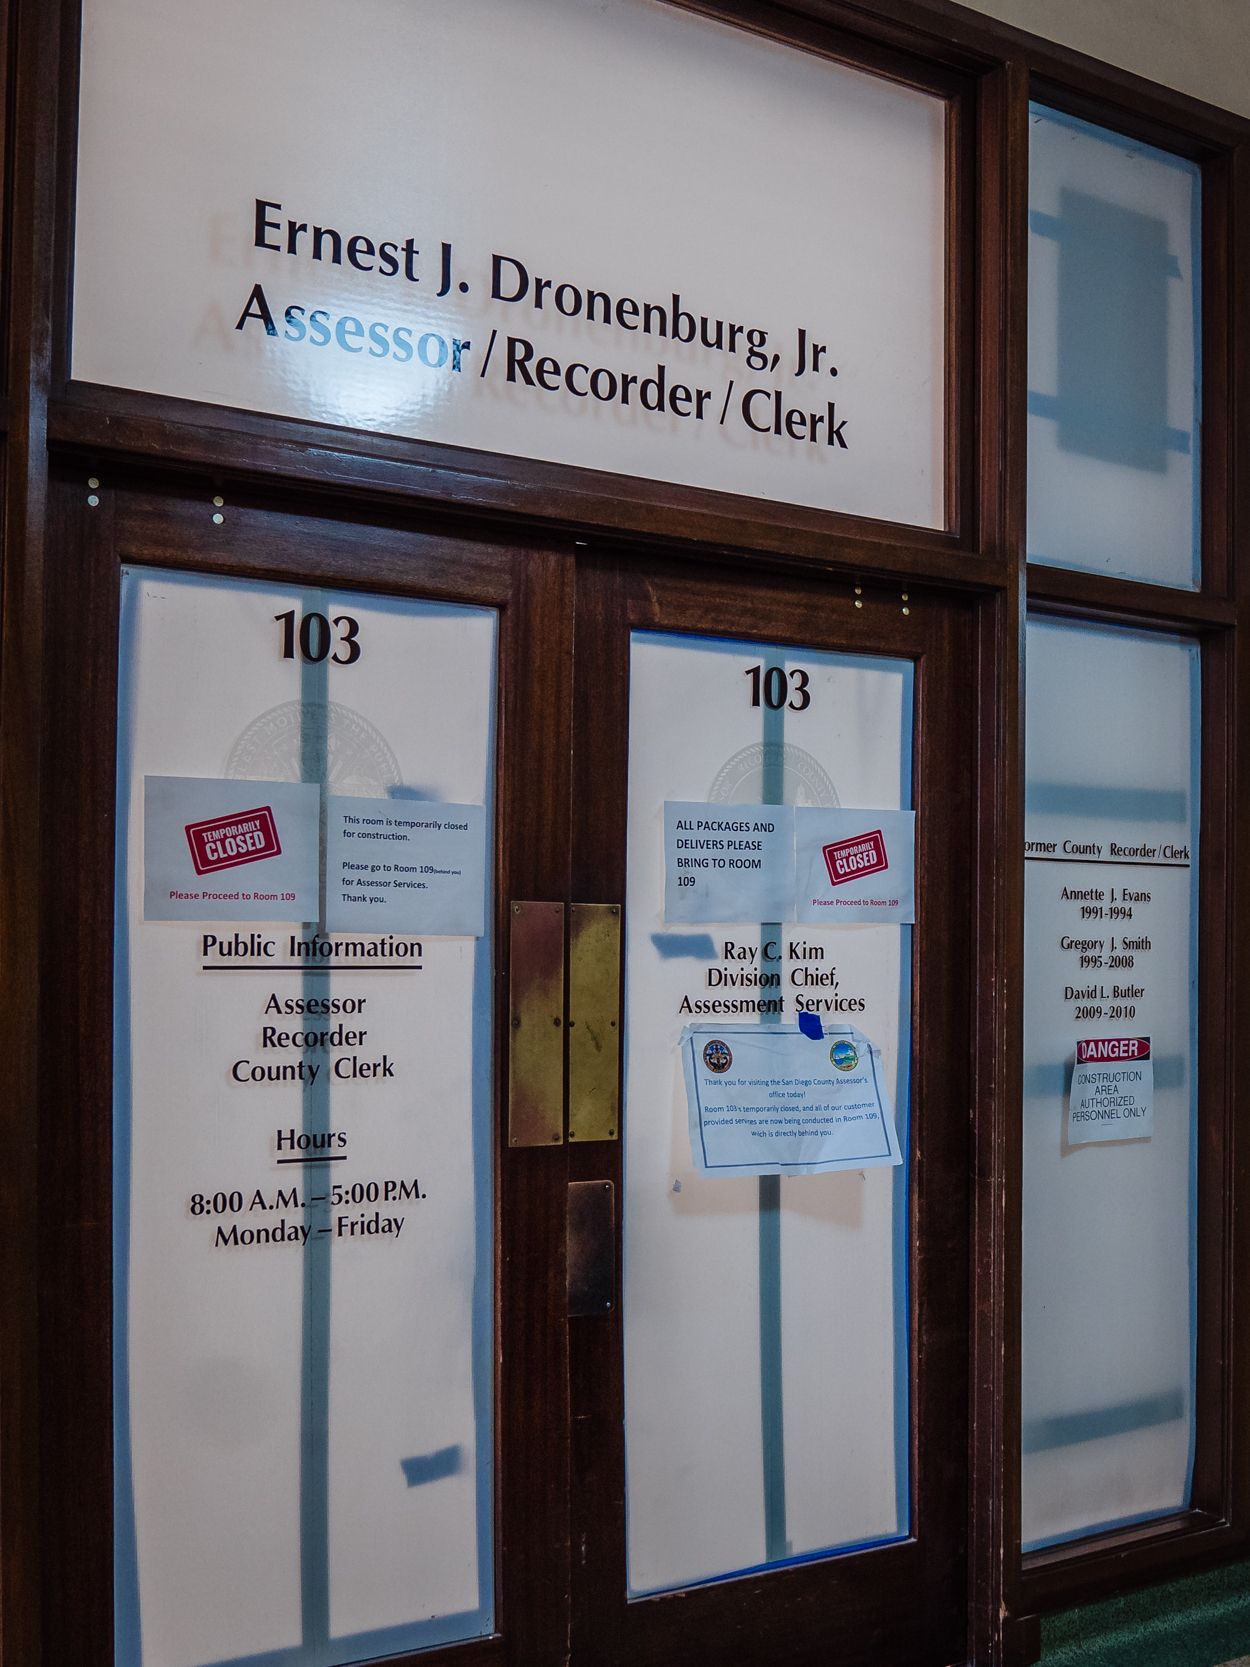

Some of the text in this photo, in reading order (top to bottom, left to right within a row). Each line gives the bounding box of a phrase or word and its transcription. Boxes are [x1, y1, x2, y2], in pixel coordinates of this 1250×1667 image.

[254, 198, 838, 377] Ernest J. Dronenburg, Jr.
[274, 609, 361, 665] 103
[744, 664, 811, 711] 103
[343, 815, 468, 831] This room is temporarily closed
[676, 820, 775, 833] ALL PACKAGES AND
[202, 820, 261, 843] TEMPORARILY
[343, 829, 411, 842] for construction.
[205, 830, 266, 861] CLOSED
[676, 839, 762, 851] DELIVERS PLEASE
[833, 840, 875, 859] TEMPORARILY
[1024, 841, 1058, 853] ormer
[1063, 840, 1103, 859] County
[342, 861, 369, 871] Please
[371, 864, 381, 873] go
[383, 864, 392, 872] to
[394, 864, 417, 873] Room
[677, 857, 762, 870] BRING TO ROOM
[836, 850, 878, 875] CLOSED
[342, 877, 428, 889] for Assessor Services.
[677, 876, 696, 887] 109
[169, 890, 296, 901] Please Proceed to Room 109
[342, 893, 387, 904] Thank you.
[812, 898, 899, 907] Please Proceed to Room 109
[1061, 886, 1151, 904] Annette J. Evans
[1080, 906, 1133, 920] 1991-1994
[202, 933, 423, 957] Public Information
[724, 941, 825, 964] Ray C. Kim
[1061, 936, 1152, 953] Gregory J. Smith
[1079, 955, 1134, 969] 1995-2008
[708, 967, 839, 989] Division Chief,
[1064, 984, 1145, 1000] David L. Butler
[264, 993, 366, 1015] Assessor
[679, 993, 866, 1014] Assessment Services
[1075, 1005, 1136, 1019] 2009-2010
[262, 1023, 367, 1048] Recorder
[1082, 1040, 1138, 1058] DANGER
[231, 1055, 394, 1085] County Clerk
[1078, 1071, 1142, 1085] CONSTRUCTION
[748, 1079, 769, 1087] visiting
[795, 1079, 812, 1087] Diego
[813, 1078, 834, 1087] County
[1094, 1085, 1119, 1095] AREA
[787, 1091, 806, 1099] today!
[1080, 1096, 1135, 1109] AUTHORIZED
[743, 1105, 779, 1113] temporarily
[780, 1105, 801, 1113] closed,
[844, 1102, 875, 1110] customer
[1072, 1107, 1147, 1122] PERSONNEL ONLY
[703, 1118, 733, 1127] provided
[784, 1117, 801, 1125] being
[843, 1114, 863, 1123] Room
[865, 1112, 880, 1120] 109,
[276, 1128, 347, 1151] Hours
[775, 1129, 797, 1138] directly
[798, 1129, 818, 1137] behind
[190, 1191, 243, 1216] 8:00
[249, 1187, 306, 1212] A.M.
[331, 1182, 380, 1206] 5:00
[384, 1178, 427, 1202] P.M.
[214, 1219, 312, 1247] Monday
[337, 1212, 405, 1238] Friday
